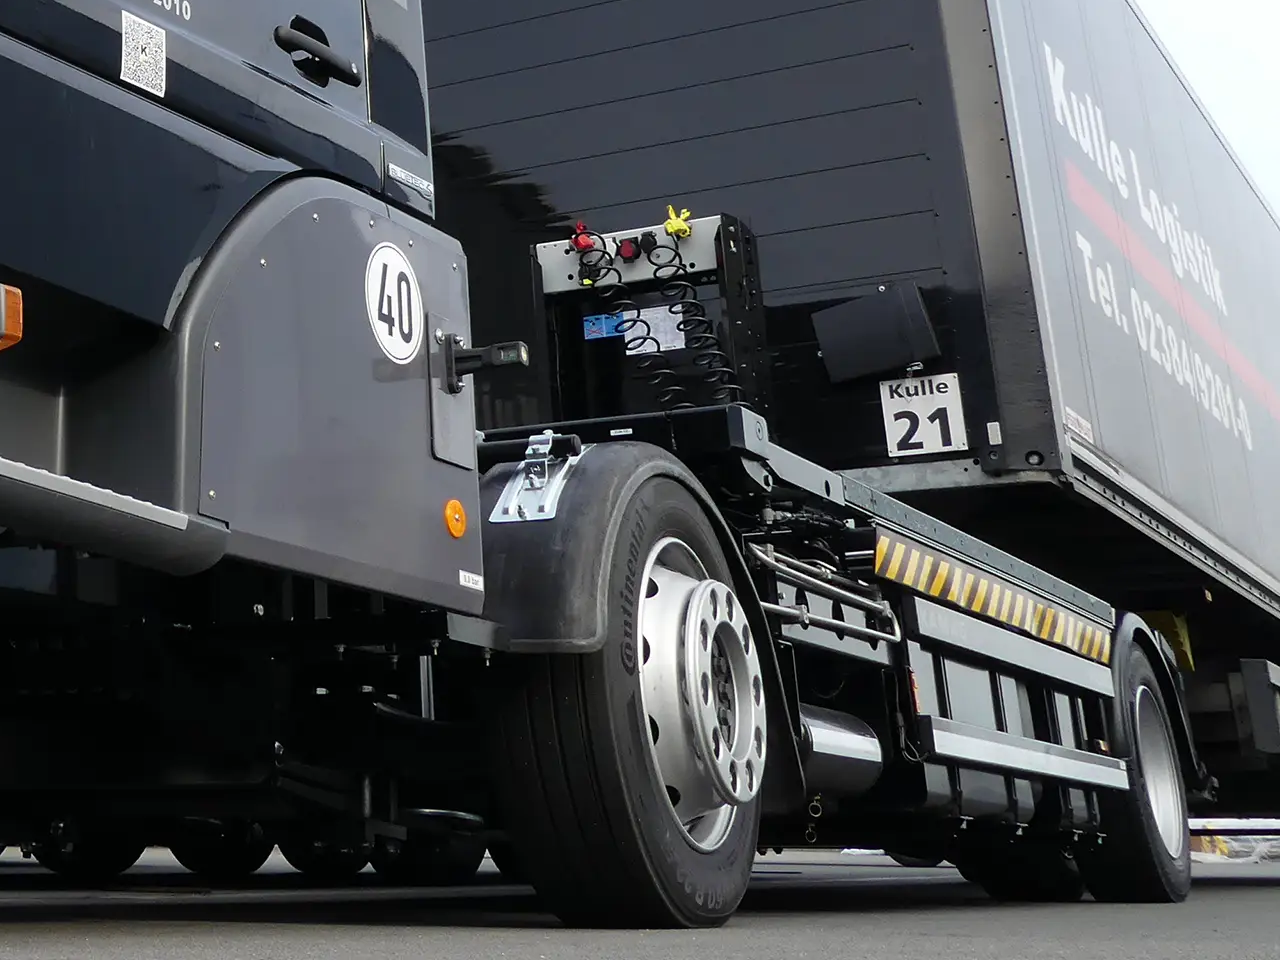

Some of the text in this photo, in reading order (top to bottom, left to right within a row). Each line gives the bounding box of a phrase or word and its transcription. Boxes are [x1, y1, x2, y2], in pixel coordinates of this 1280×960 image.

[1043, 41, 1228, 318] Kulle Logistik
[377, 262, 413, 344] 40
[1075, 230, 1252, 451] Tel. 02384/9201-0
[888, 379, 949, 400] Kulle
[893, 407, 952, 451] 21
